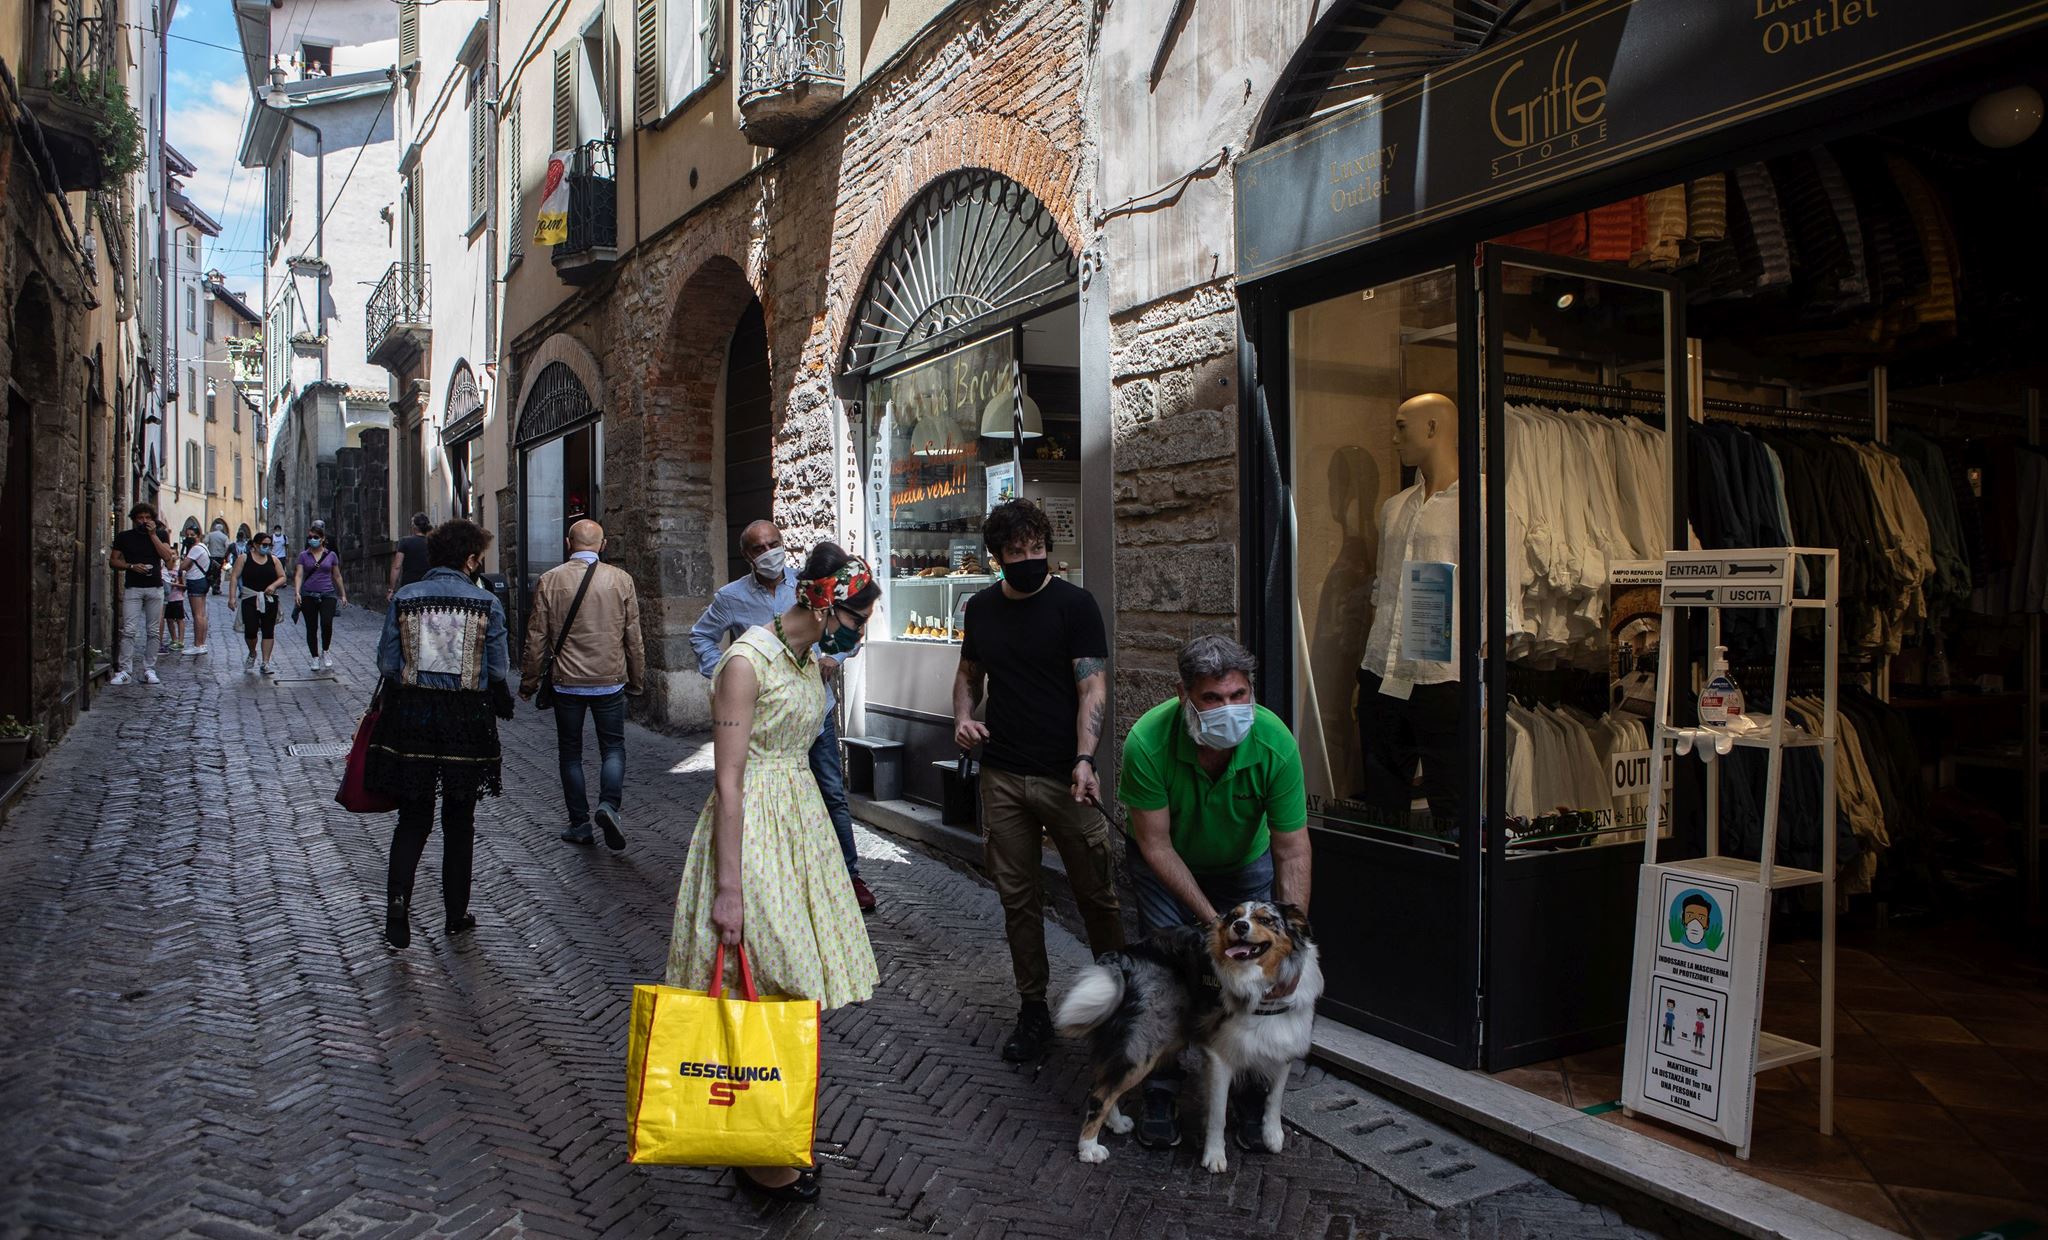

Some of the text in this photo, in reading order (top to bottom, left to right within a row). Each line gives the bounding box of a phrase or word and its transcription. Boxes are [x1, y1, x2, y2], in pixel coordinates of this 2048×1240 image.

[1761, 0, 1880, 54] Outlet
[1490, 39, 1607, 148] Griffe
[1490, 121, 1608, 178] STORE
[1329, 141, 1398, 184] Luxury
[1330, 175, 1391, 213] Outlet
[1670, 565, 1718, 576] ENTRATA
[1730, 590, 1771, 602] USCITA
[1614, 755, 1672, 788] OUTT
[1626, 802, 1670, 825] HON
[1658, 955, 1687, 968] INDOSSARE
[1694, 963, 1729, 978] MASCHERINA
[1672, 967, 1678, 975] DI
[1679, 969, 1710, 983] PROTEZIONE
[679, 1061, 782, 1082] ESSELUNGA
[1651, 1066, 1712, 1093] LA DISTANZA DI 1m TRA
[1667, 1060, 1698, 1077] MANTENERE
[1660, 1080, 1671, 1091] UNA
[1672, 1083, 1697, 1099] PERSONA
[1670, 1094, 1690, 1107] L'ALTRA
